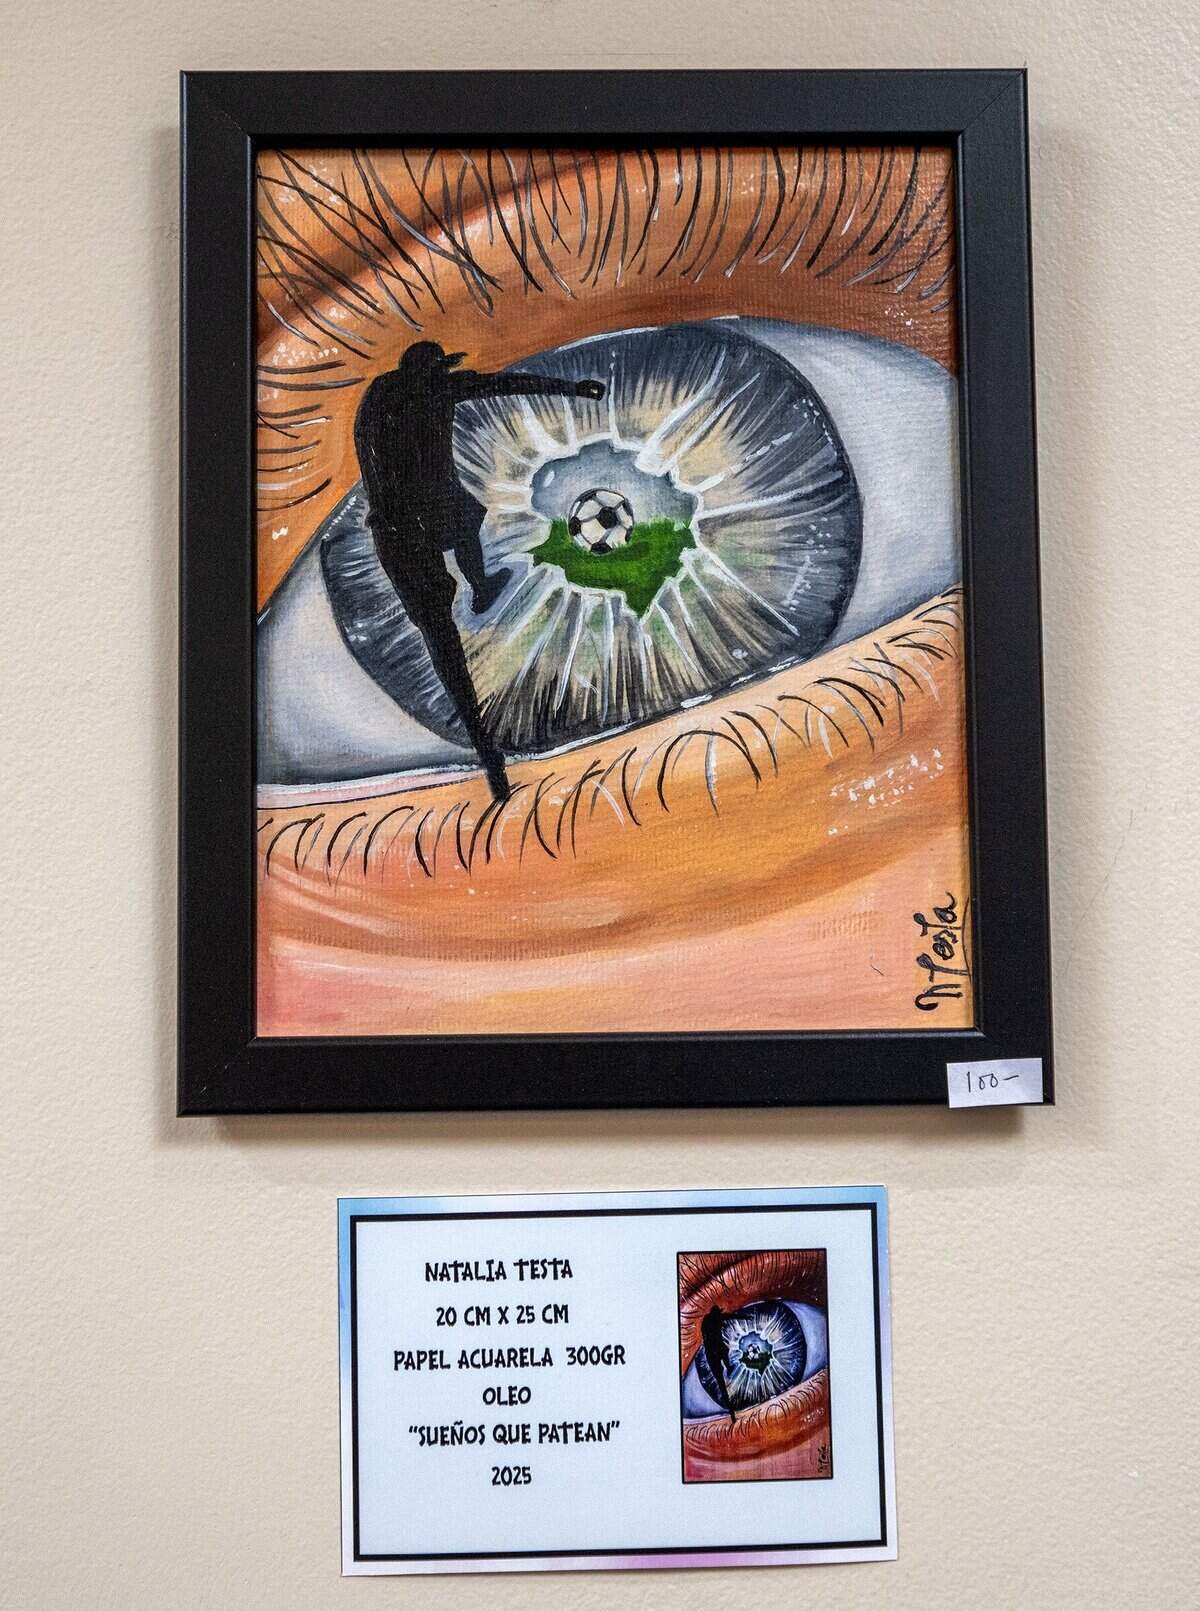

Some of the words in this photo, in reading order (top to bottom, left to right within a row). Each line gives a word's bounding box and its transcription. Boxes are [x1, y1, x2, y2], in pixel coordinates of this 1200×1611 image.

[425, 1258, 508, 1283] NATALIA
[513, 1257, 574, 1282] TESTA
[436, 1306, 458, 1327] 20
[463, 1305, 491, 1327] CM
[497, 1305, 510, 1326] X
[516, 1304, 536, 1325] 25
[541, 1303, 569, 1325] CM
[393, 1350, 451, 1371] PAPEL
[457, 1347, 554, 1370] ACUARELA
[566, 1344, 626, 1366] 300GR
[482, 1385, 532, 1406] OLEO
[492, 1423, 532, 1445] QUE
[491, 1465, 532, 1487] 2025
